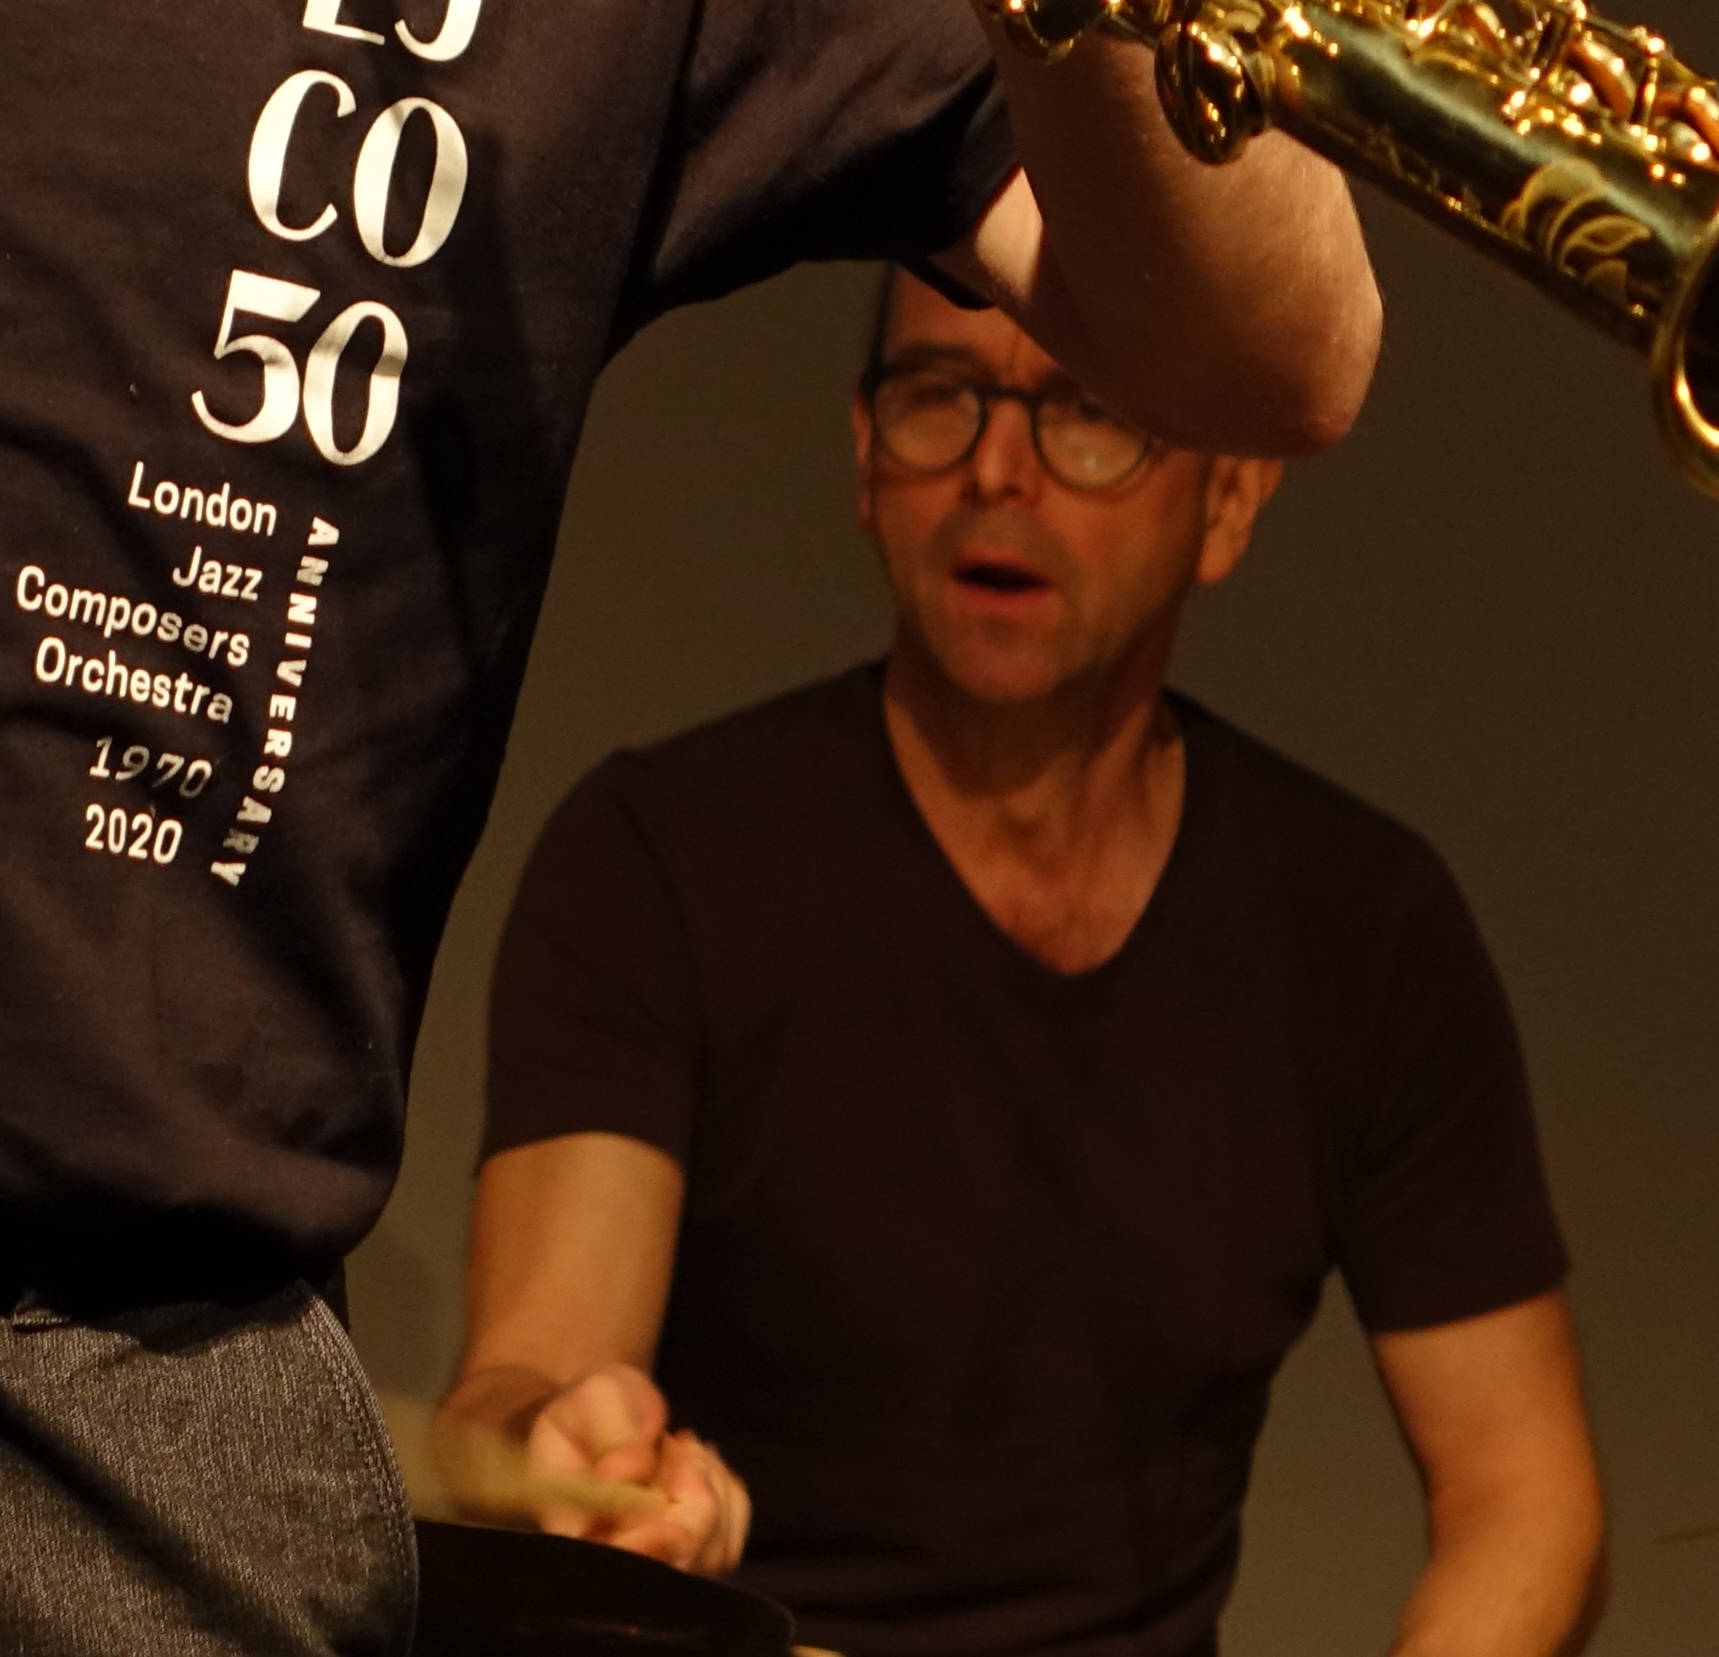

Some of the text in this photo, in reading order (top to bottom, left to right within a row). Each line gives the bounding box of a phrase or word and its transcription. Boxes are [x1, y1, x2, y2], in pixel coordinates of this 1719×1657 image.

[245, 68, 469, 269] CO
[190, 268, 410, 467] 50
[127, 460, 278, 538] London
[15, 564, 252, 670] Composers
[171, 545, 264, 603] Jazz
[34, 636, 234, 725] Orchestra
[210, 515, 341, 888] ANNIVERSARY
[88, 736, 214, 800] 1970
[84, 802, 184, 867] 2020
